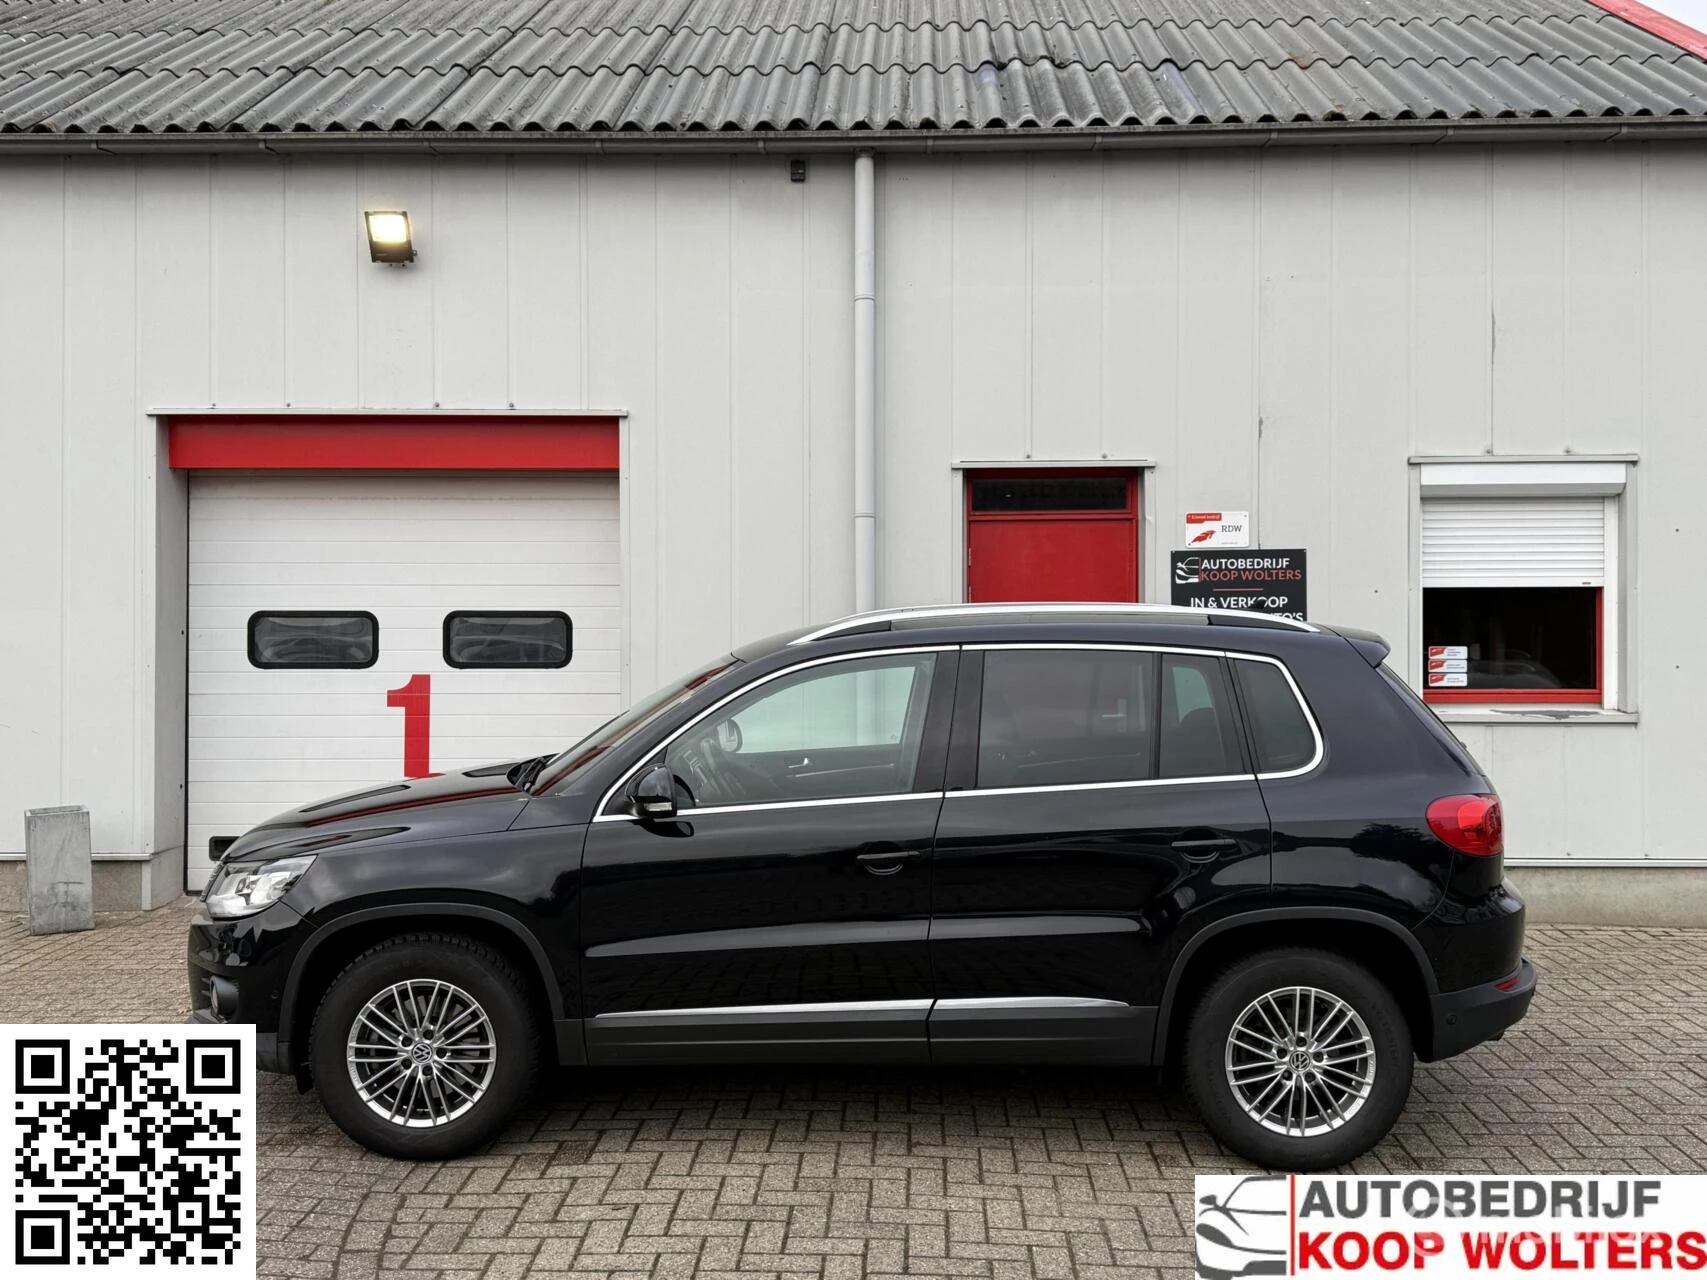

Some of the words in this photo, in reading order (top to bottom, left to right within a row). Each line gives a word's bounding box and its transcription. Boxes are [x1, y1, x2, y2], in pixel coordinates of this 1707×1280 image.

[1221, 525, 1242, 533] RDW
[1201, 558, 1290, 569] AUTOBEDRIJF
[1201, 570, 1239, 581] KOOP
[1241, 569, 1302, 580] WOLTERS
[1190, 597, 1205, 608] IN
[1207, 597, 1218, 608] &
[387, 674, 430, 778] 1
